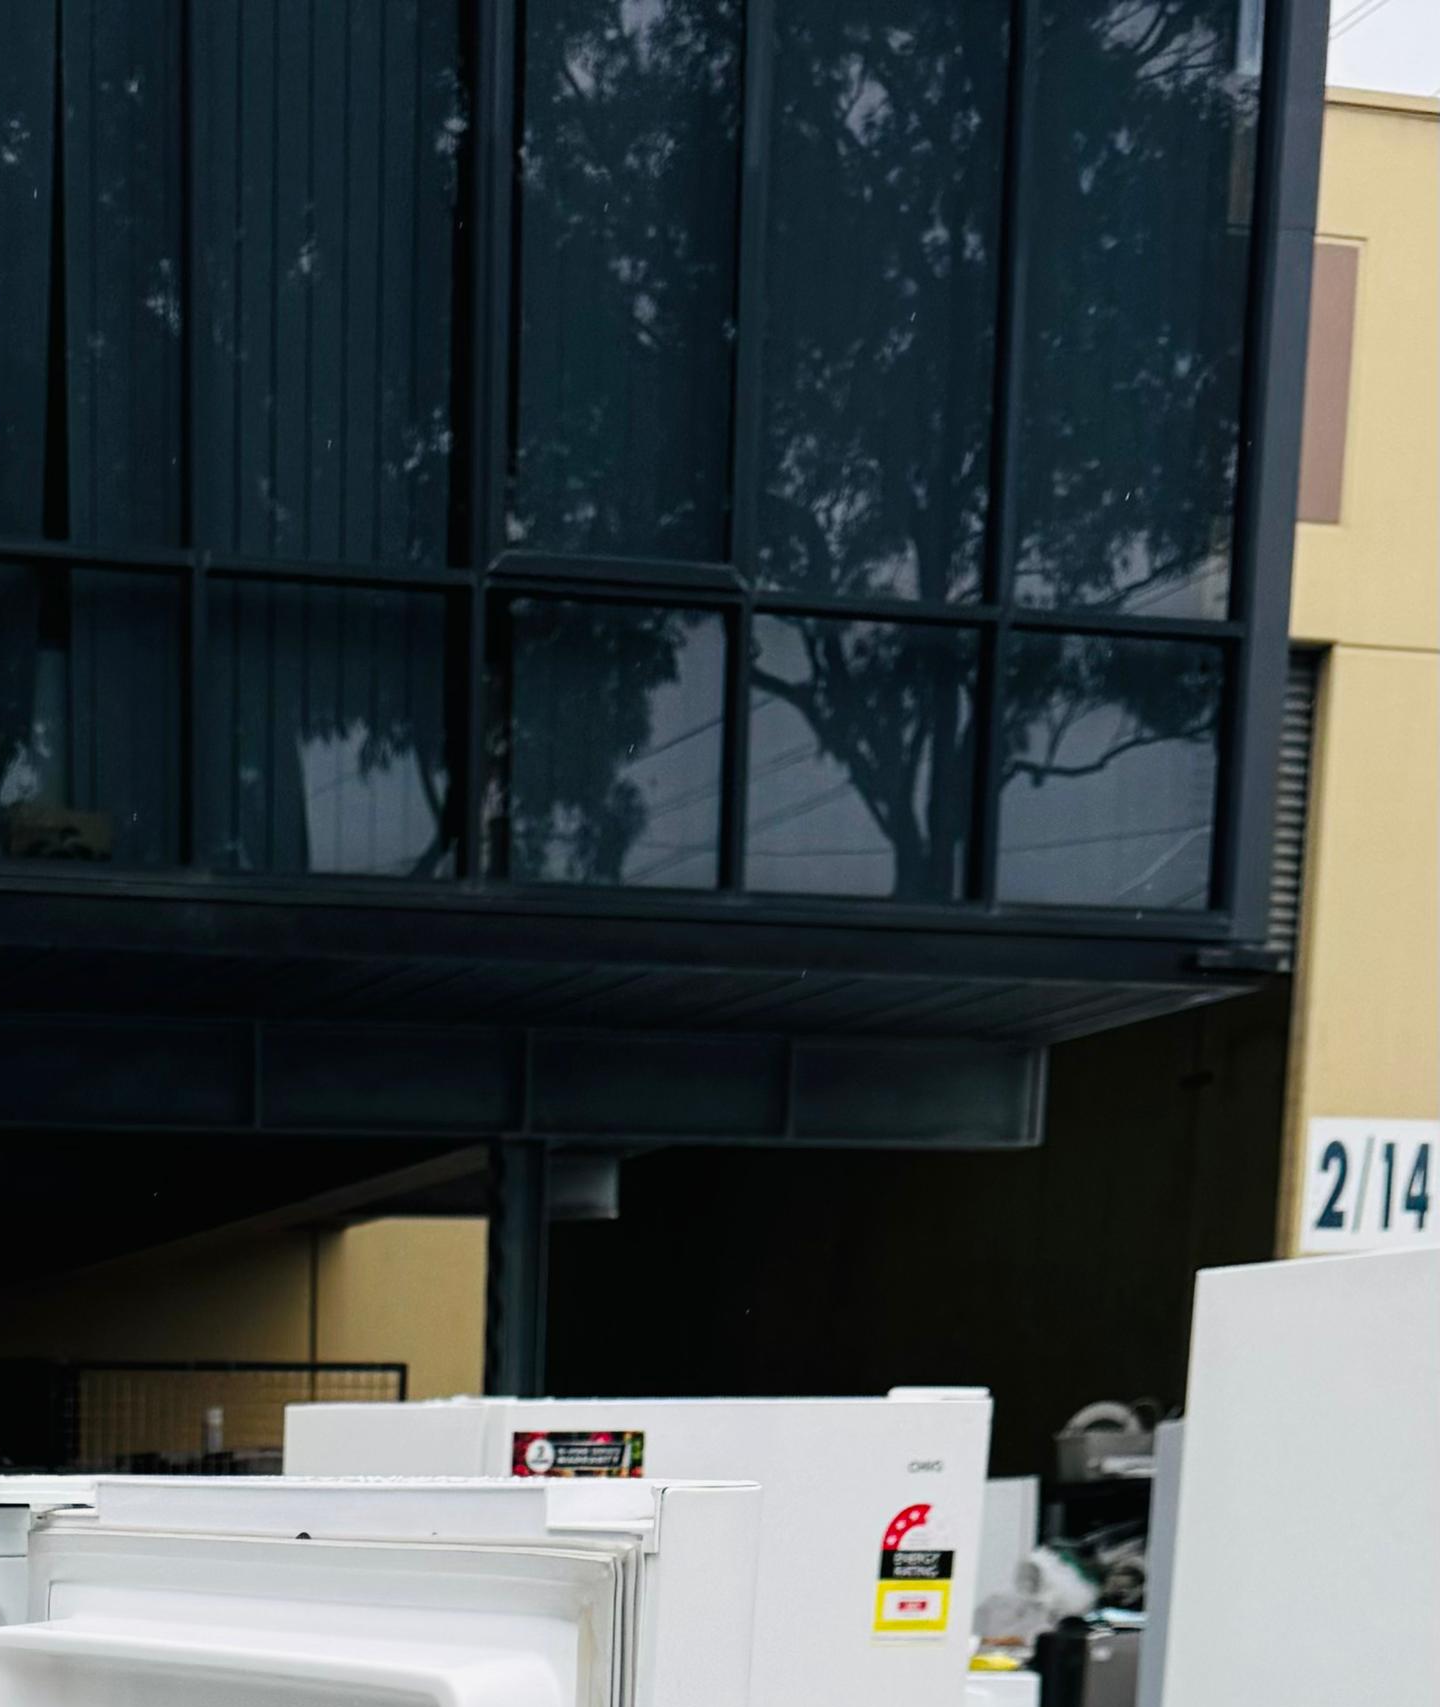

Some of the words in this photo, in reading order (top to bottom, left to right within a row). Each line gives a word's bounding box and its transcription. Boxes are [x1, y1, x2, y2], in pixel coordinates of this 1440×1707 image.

[1316, 1136, 1430, 1233] 2/14
[893, 1552, 942, 1566] ENERGY
[893, 1566, 940, 1577] RATING
